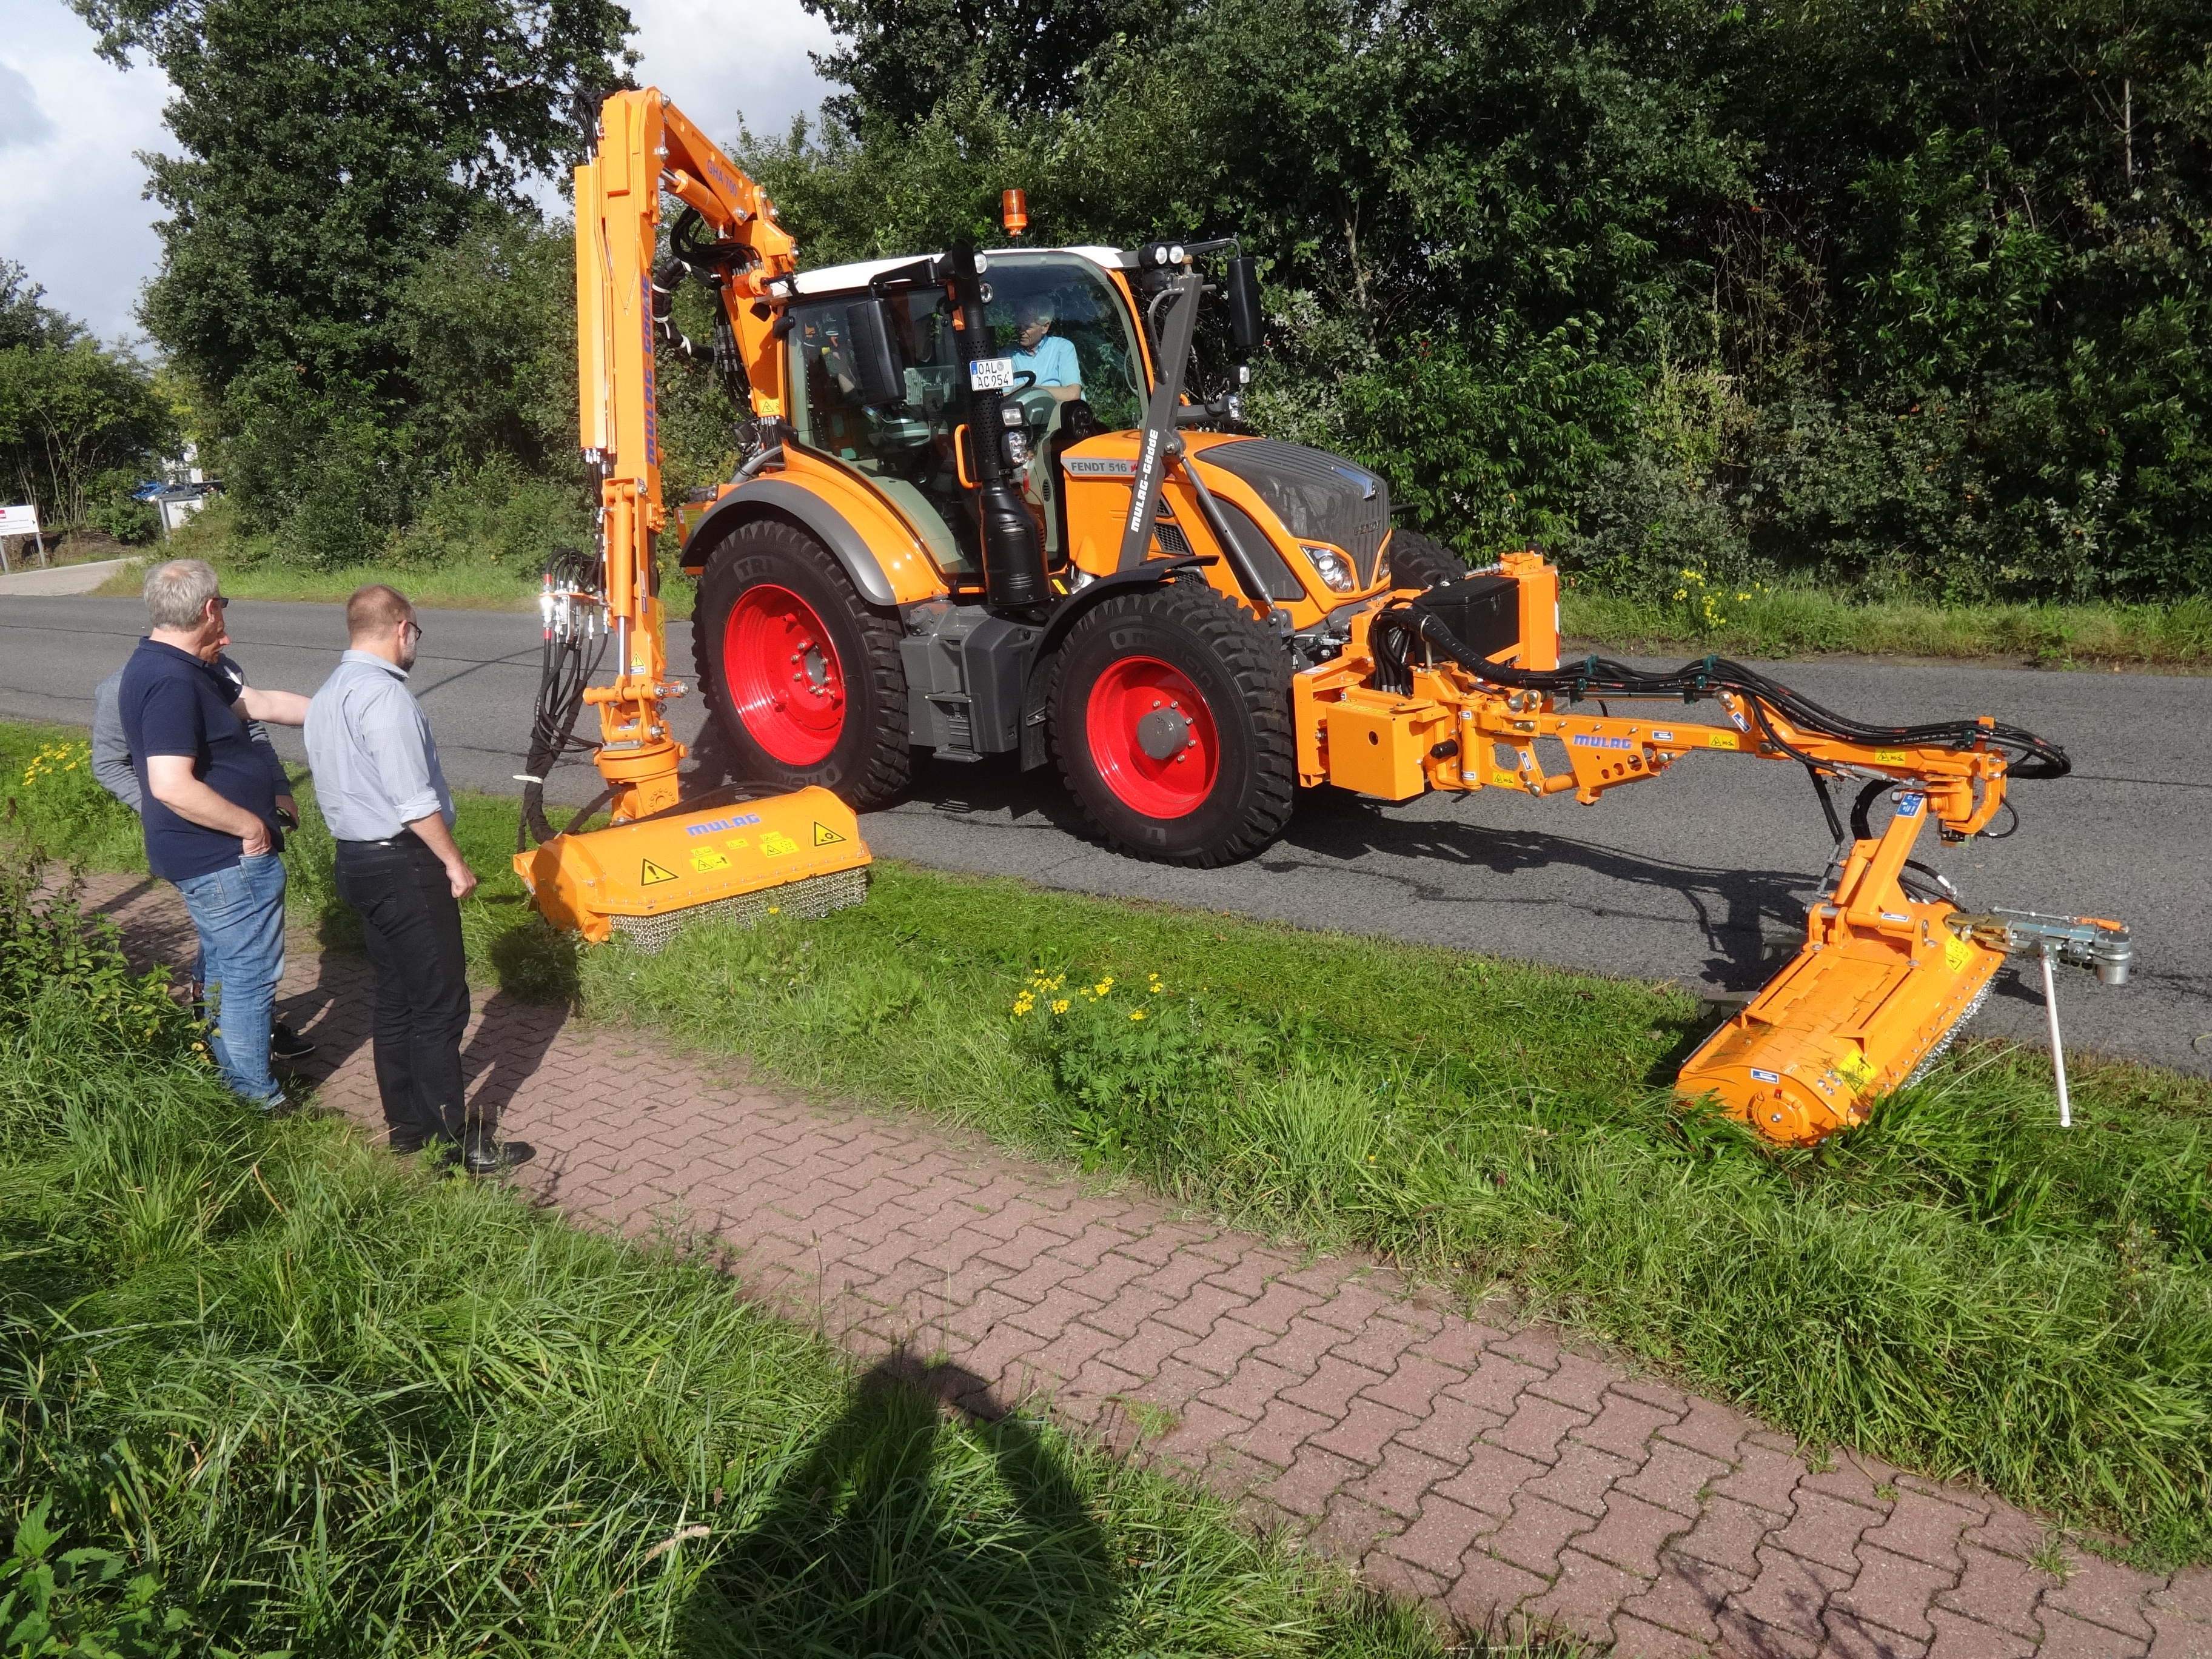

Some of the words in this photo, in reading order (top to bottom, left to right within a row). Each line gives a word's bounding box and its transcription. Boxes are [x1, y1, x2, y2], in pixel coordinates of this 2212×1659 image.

[707, 159, 723, 184] GHA
[725, 175, 737, 196] 700
[979, 362, 997, 375] OAL
[977, 377, 990, 389] AC
[991, 374, 1008, 387] 954
[1071, 462, 1105, 472] FENDT
[1109, 463, 1127, 472] 516
[1574, 734, 1632, 749] MULAG
[686, 813, 761, 836] MULAG
